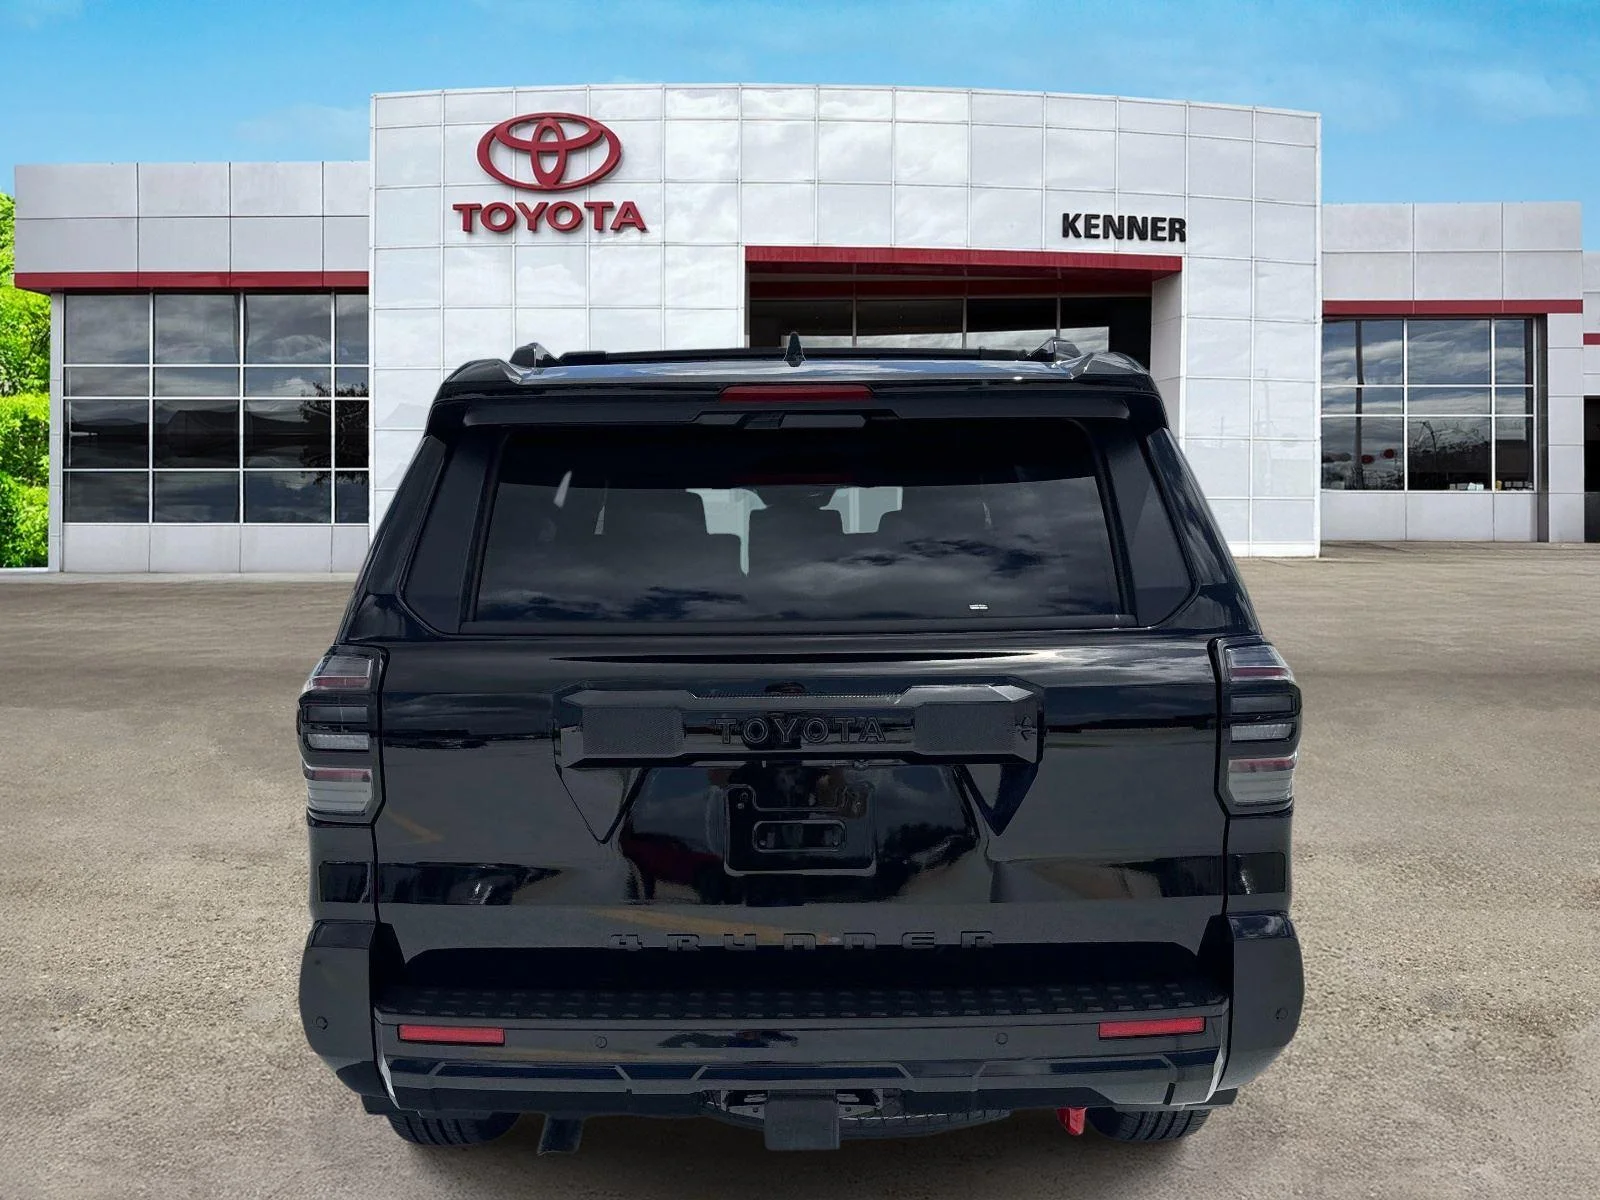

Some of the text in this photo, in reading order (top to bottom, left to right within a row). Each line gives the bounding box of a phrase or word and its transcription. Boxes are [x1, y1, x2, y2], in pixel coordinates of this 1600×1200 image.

[452, 201, 648, 233] TOYOTA
[1062, 212, 1187, 242] KENNER
[714, 716, 886, 744] TOYOTA
